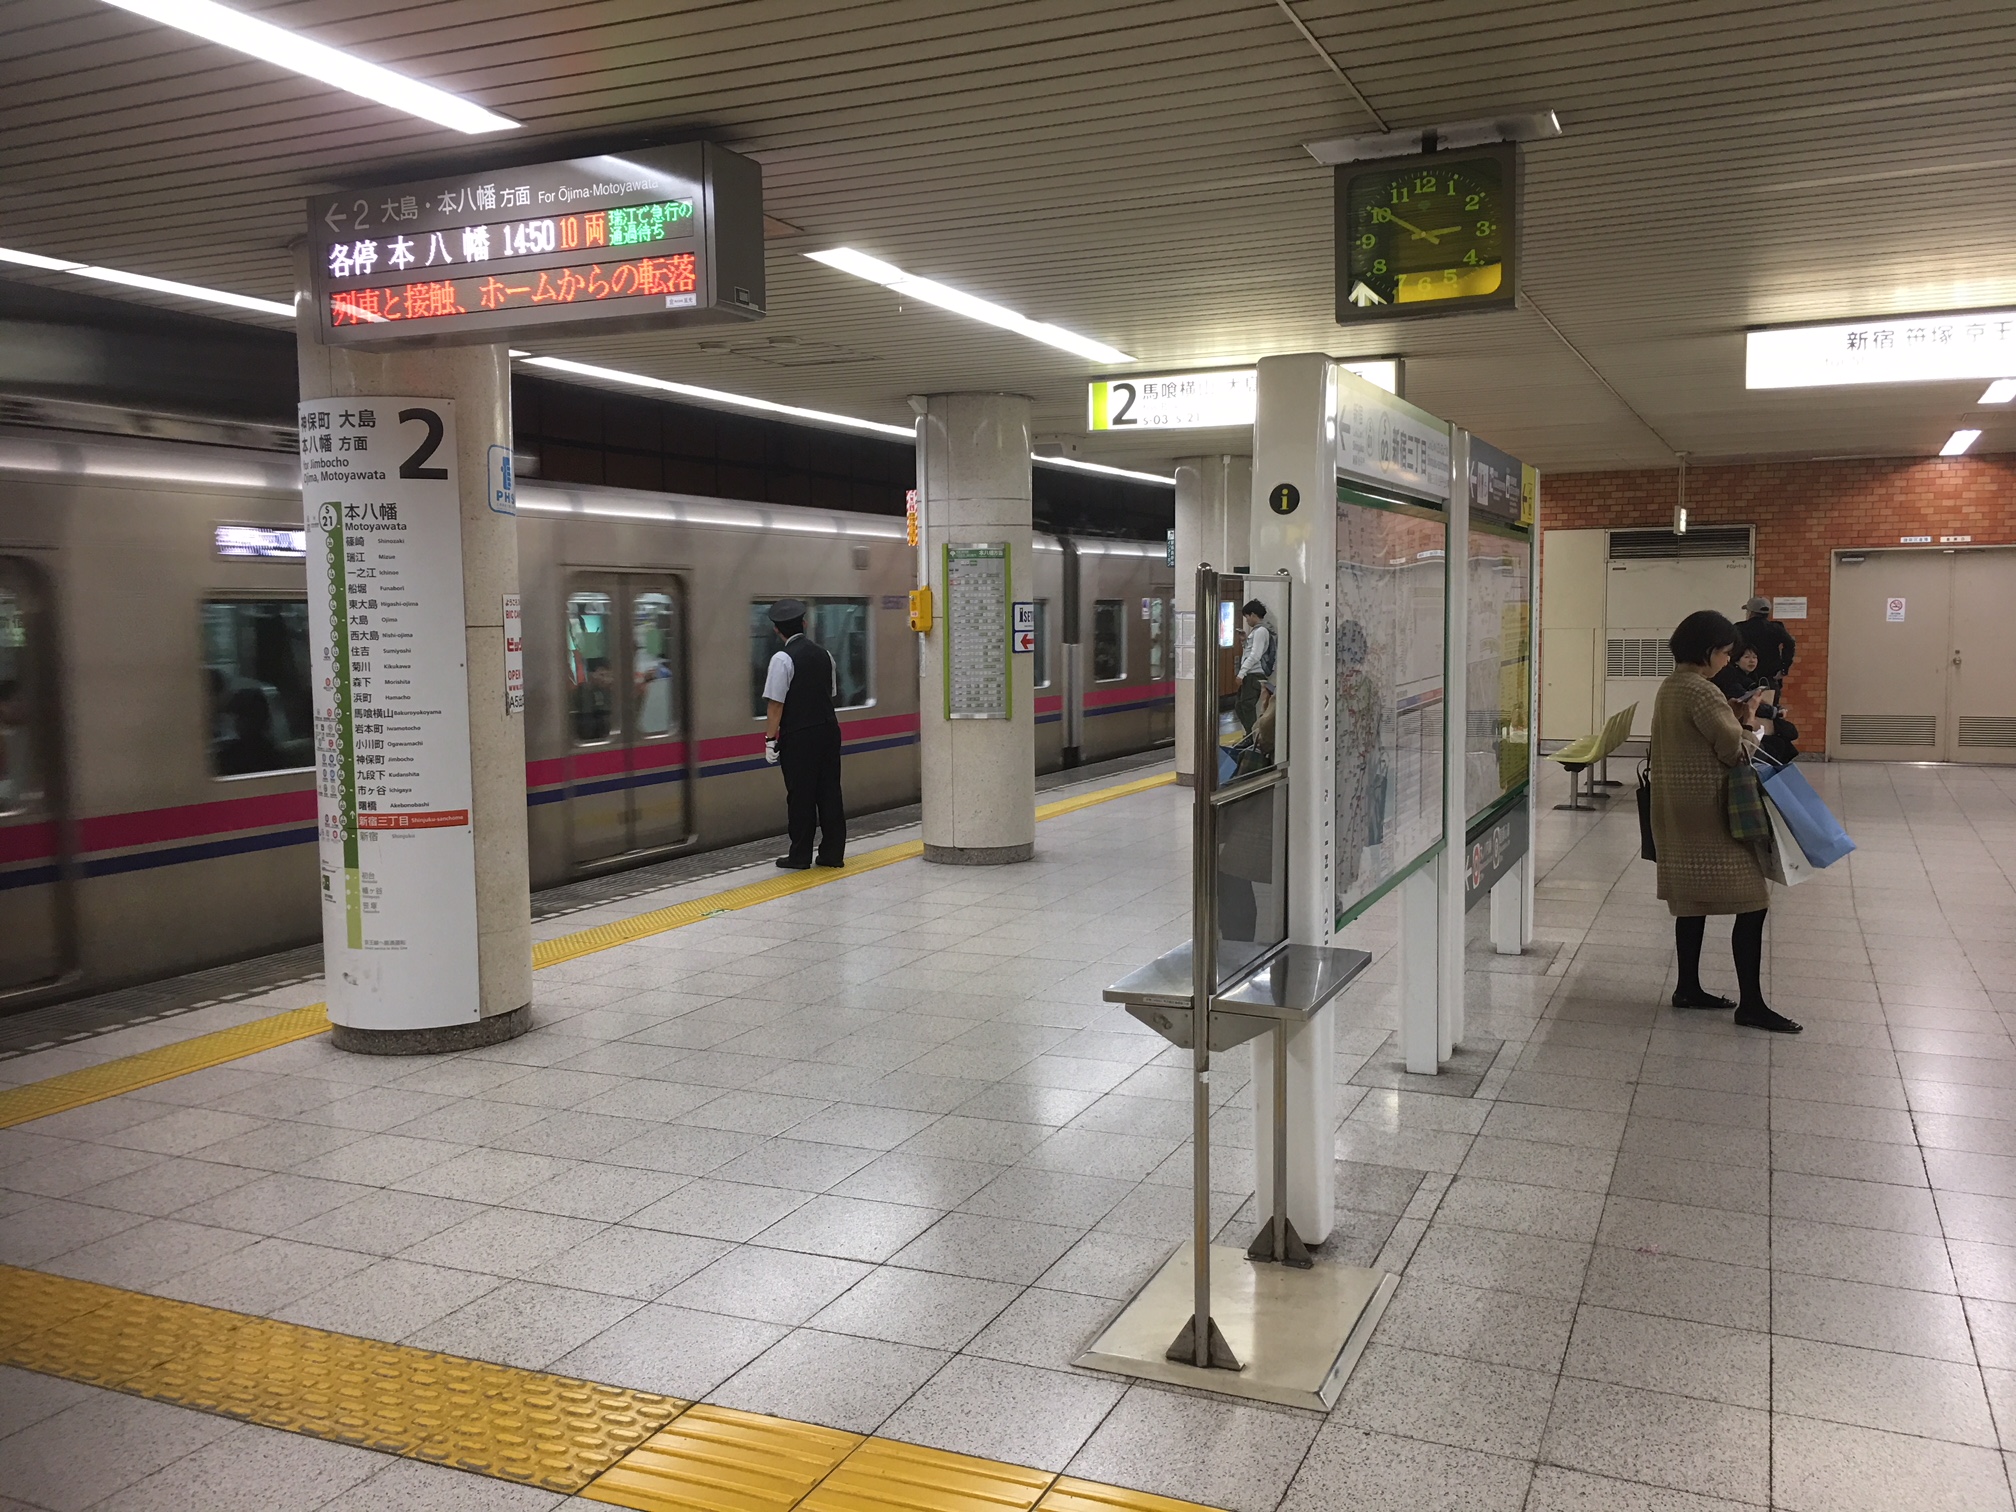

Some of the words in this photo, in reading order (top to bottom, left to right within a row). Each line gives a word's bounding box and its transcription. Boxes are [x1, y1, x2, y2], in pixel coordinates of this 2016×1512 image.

[1414, 176, 1437, 194] 12
[1447, 180, 1456, 196] 1
[1391, 187, 1410, 204] 11
[354, 199, 370, 231] 2
[500, 185, 531, 206] 方面
[538, 191, 556, 203] For
[1465, 194, 1480, 211] 2
[609, 223, 665, 246] 通過待ち
[1476, 221, 1490, 236] 3
[328, 240, 378, 278] 各停
[503, 219, 556, 257] 14:50
[559, 217, 578, 249] 10
[584, 213, 606, 248] 両
[1361, 233, 1376, 249] 9
[1463, 249, 1478, 265] 4
[1373, 259, 1387, 274] 8
[1443, 269, 1458, 284] 5
[331, 254, 696, 327] 列車と接触、ホームからの転落
[1417, 277, 1432, 292] 6
[1847, 329, 1894, 351] 新宿
[1112, 383, 1137, 426] 2
[301, 411, 331, 433] 神保町
[339, 409, 376, 428] 大島
[302, 434, 332, 455] 本八幡
[339, 436, 368, 451] 方面
[398, 408, 449, 480] 2
[310, 456, 350, 469] Jimbocho
[320, 470, 386, 483] Motoyawata
[325, 506, 330, 515] S
[344, 503, 398, 521] 本八幡
[322, 515, 333, 527] 21
[345, 522, 407, 533] Motoyawata
[347, 552, 365, 563] 瑞江
[347, 568, 376, 578] 一之江
[348, 584, 367, 594] 船堀
[349, 599, 378, 610] 東大島
[350, 615, 368, 625] 大島
[350, 631, 379, 641] 西大島
[351, 646, 370, 657] 住吉
[352, 662, 371, 672] 菊川
[352, 677, 371, 688] 森下
[353, 693, 372, 703] 浜町
[354, 708, 393, 719] 馬喰横山
[355, 724, 383, 734] 岩本町
[356, 739, 384, 750] 小川町
[356, 755, 385, 765] 神保町
[357, 770, 386, 780] 九段下
[359, 816, 409, 827] 新宿三丁目
[360, 832, 378, 842] 新宿
